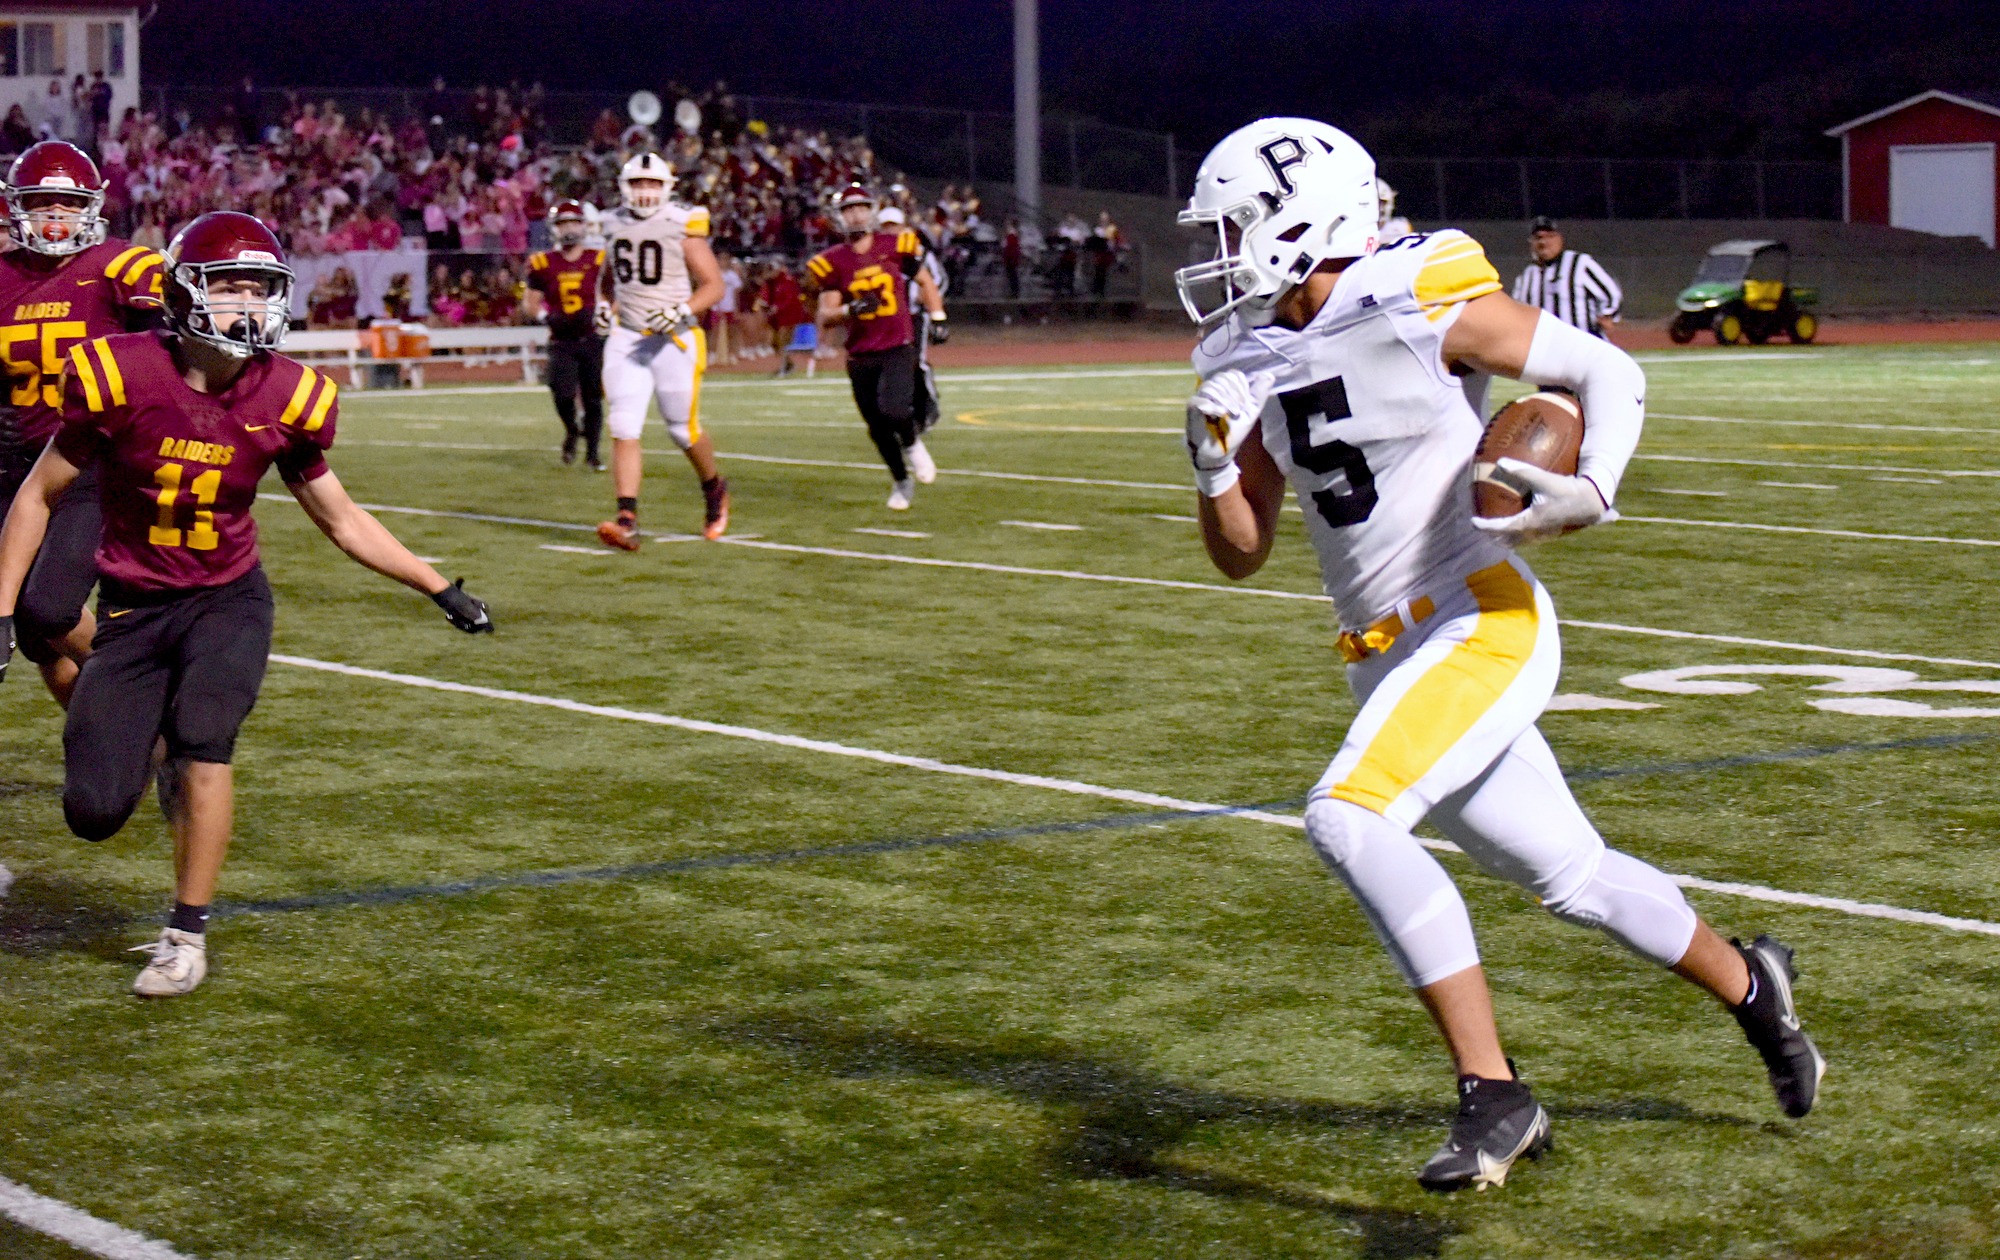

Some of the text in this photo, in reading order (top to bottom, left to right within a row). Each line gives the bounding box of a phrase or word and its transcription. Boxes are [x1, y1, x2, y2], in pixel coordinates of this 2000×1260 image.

[1256, 133, 1313, 200] P
[614, 238, 663, 285] 60
[14, 301, 72, 320] RAIDERS
[558, 281, 583, 314] 5
[0, 321, 87, 408] 55
[158, 436, 236, 466] RAIDERS
[1277, 375, 1379, 529] 5
[148, 462, 223, 551] 11
